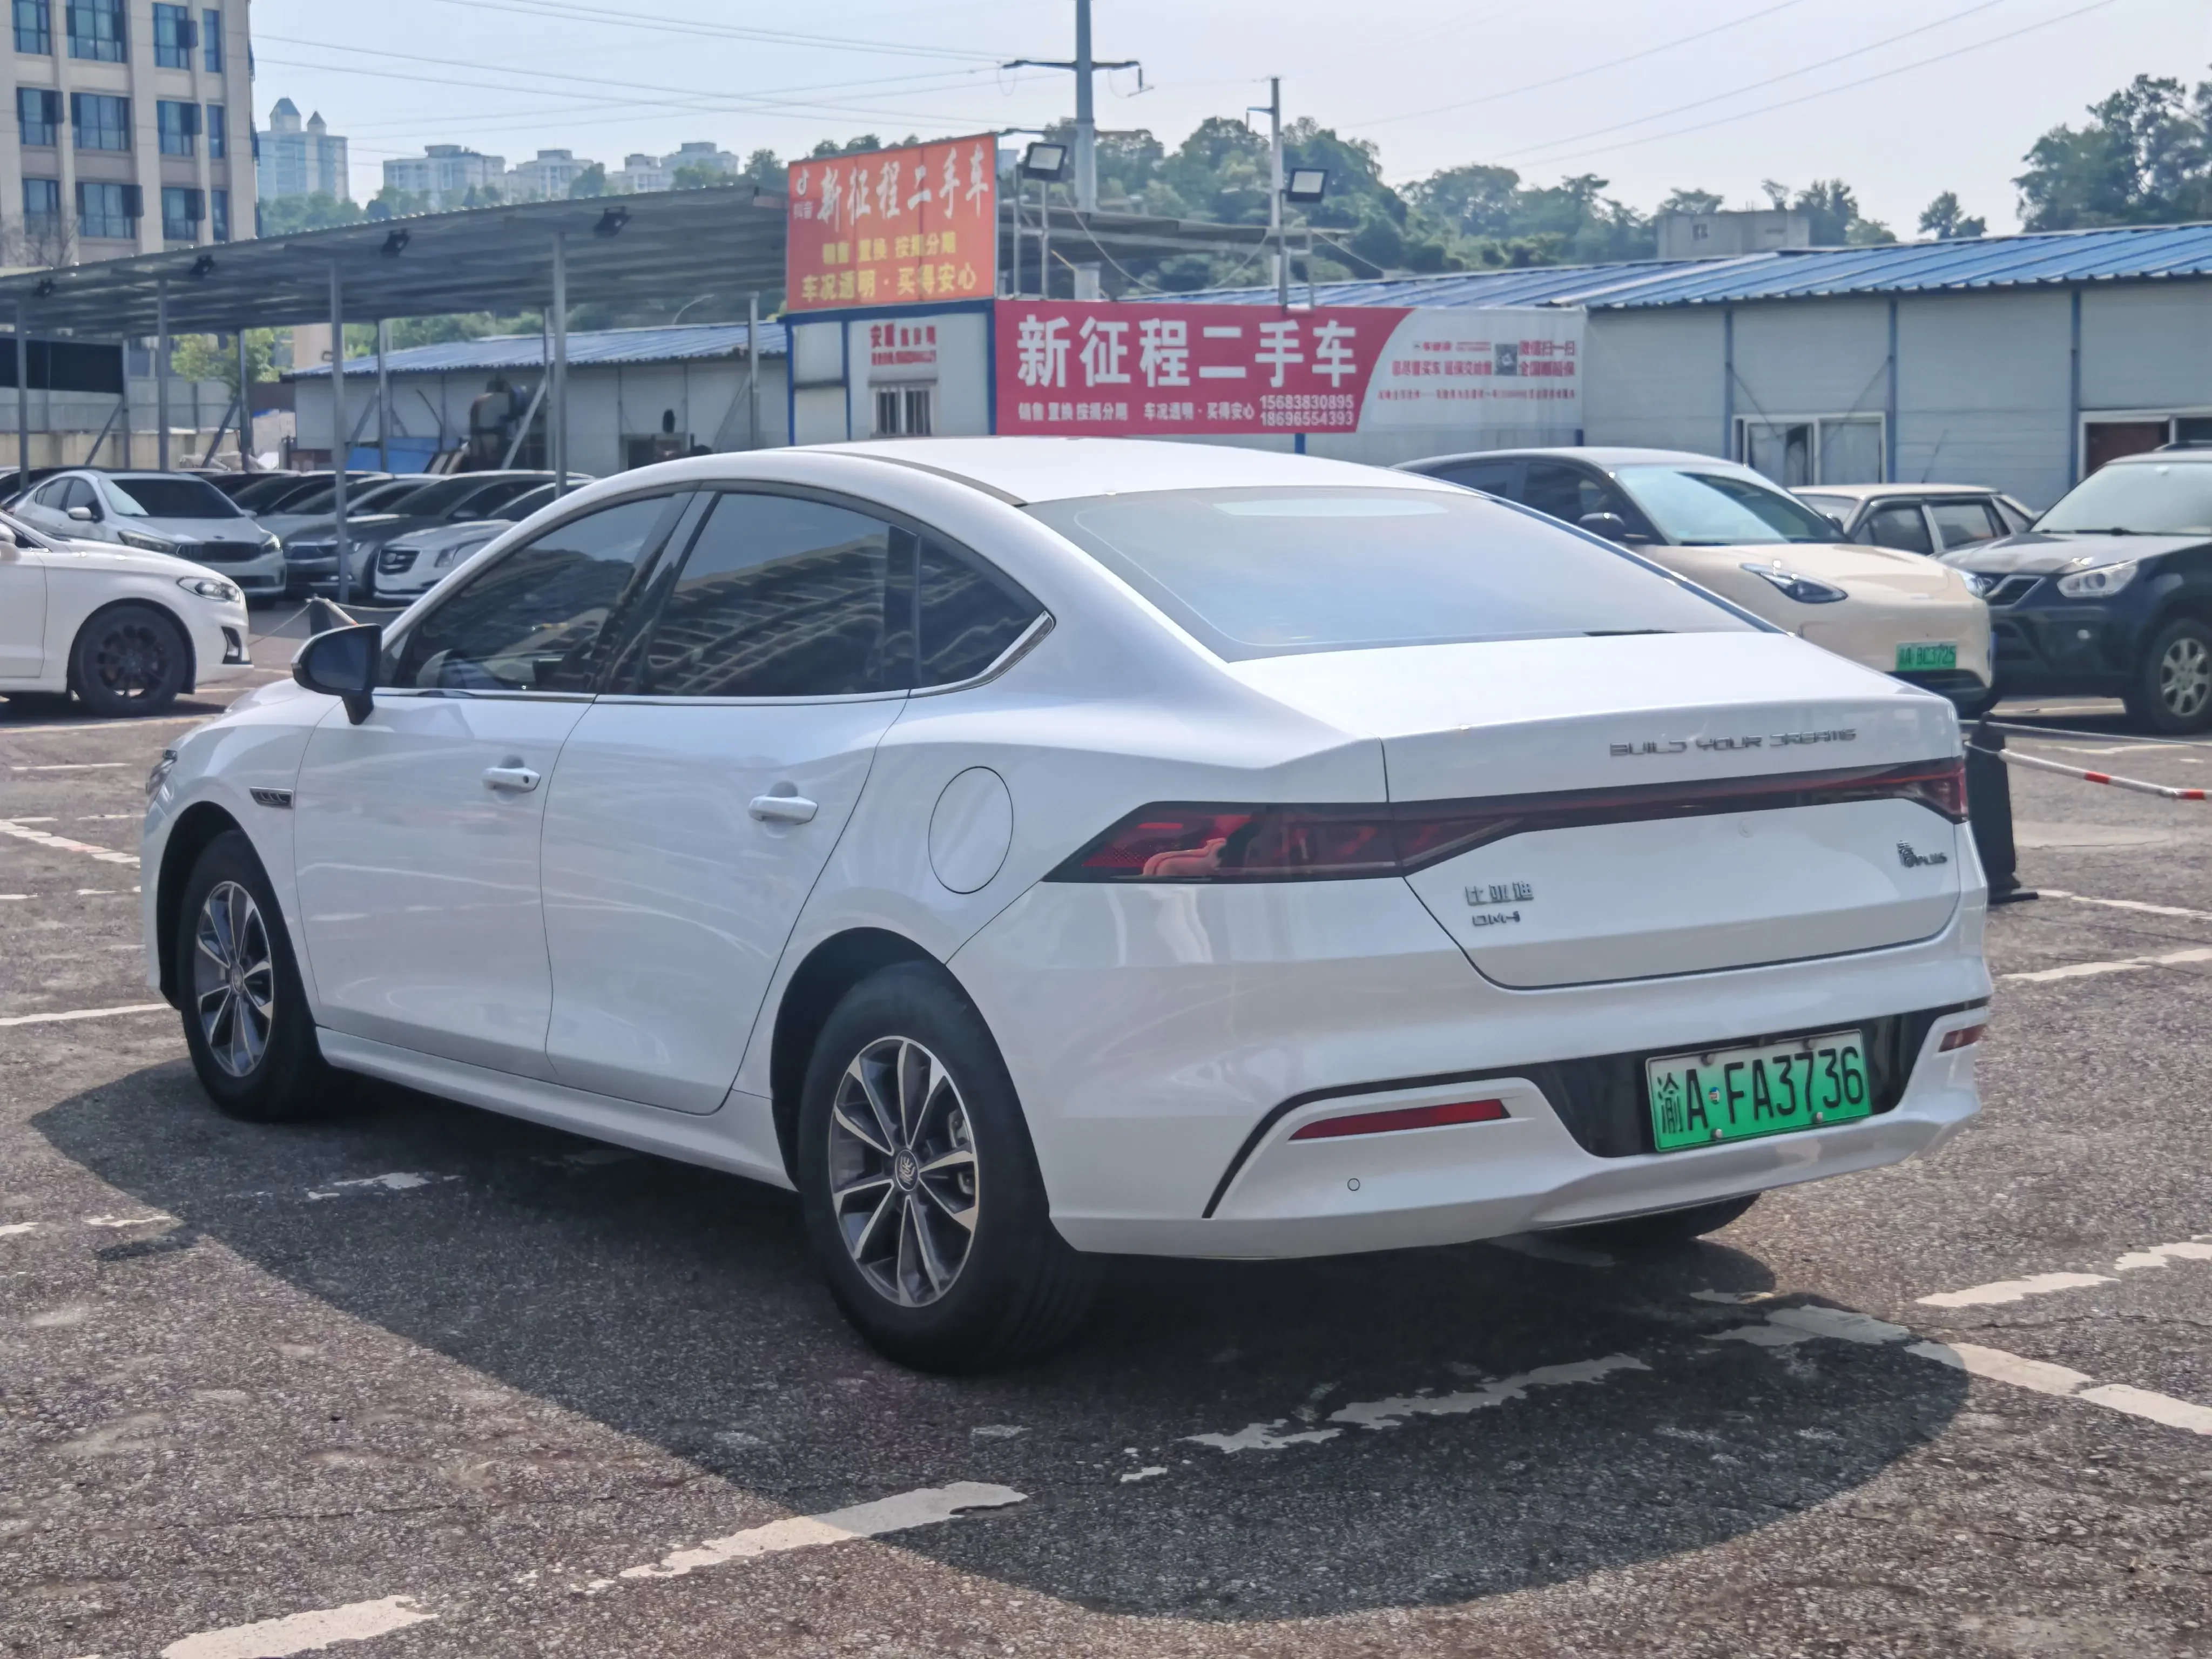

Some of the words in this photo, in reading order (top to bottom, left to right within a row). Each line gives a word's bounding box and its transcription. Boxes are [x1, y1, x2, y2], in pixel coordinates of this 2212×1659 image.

[817, 143, 989, 233] 新征程二手车
[1017, 315, 1357, 388] 新征程二手车
[1610, 740, 1688, 757] BUILD
[1696, 735, 1762, 751] YOUR
[1769, 728, 1857, 747] DREAMS
